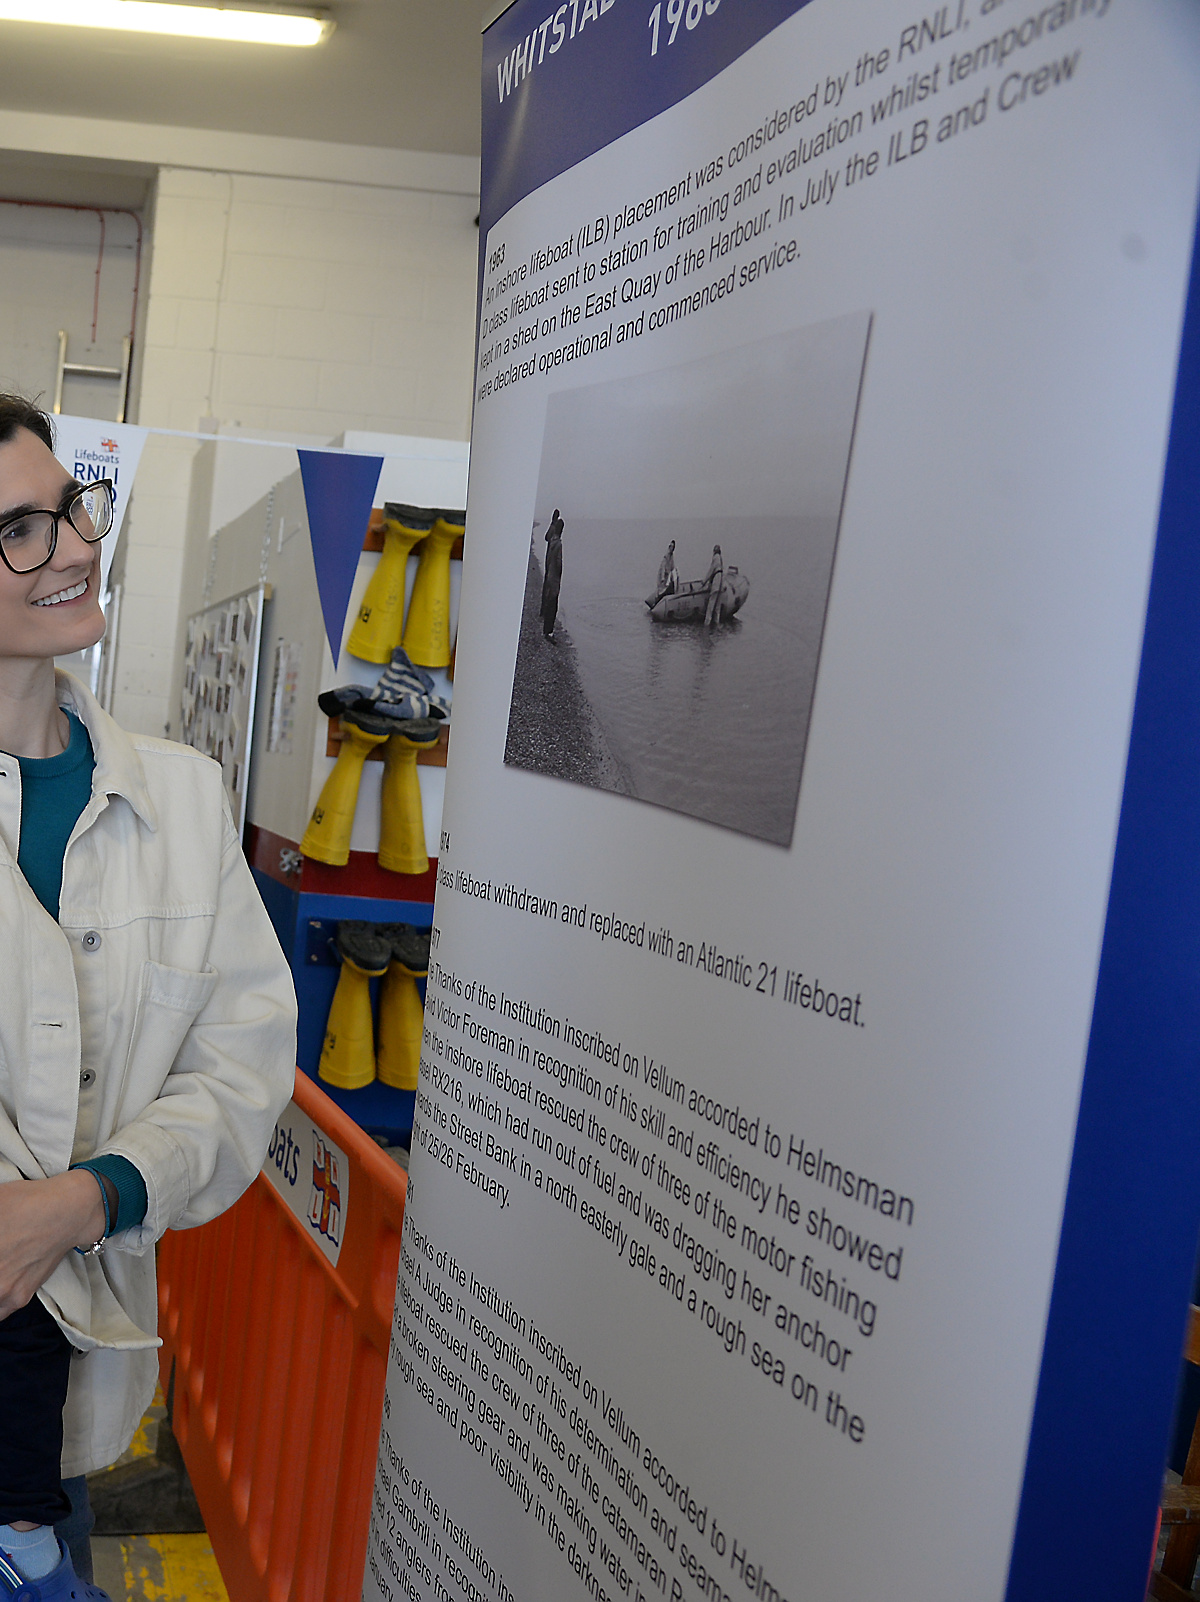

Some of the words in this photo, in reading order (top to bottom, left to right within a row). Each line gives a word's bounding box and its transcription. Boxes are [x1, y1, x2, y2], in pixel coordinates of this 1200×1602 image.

[488, 242, 506, 275] 1963
[489, 308, 508, 333] class
[510, 280, 550, 319] lifeboat
[552, 265, 582, 298] sent
[581, 261, 598, 284] to
[598, 239, 648, 276] station
[653, 225, 674, 252] for
[678, 192, 729, 240] training
[734, 164, 762, 206] and
[767, 112, 862, 185] evaluation
[872, 65, 940, 124] whilst
[494, 340, 502, 360] in
[504, 338, 510, 354] a
[512, 318, 541, 350] shed
[539, 316, 556, 338] on
[561, 305, 583, 329] the
[582, 285, 617, 319] East
[621, 270, 661, 303] Quay
[665, 254, 681, 285] of
[684, 249, 705, 276] the
[709, 209, 771, 262] Harbour.
[779, 194, 794, 222] In
[800, 170, 839, 210] July
[846, 151, 879, 186] the
[888, 120, 928, 165] ILB
[937, 89, 988, 142] and
[999, 54, 1078, 111] Crew
[495, 264, 527, 298] inshore
[530, 234, 573, 276] lifeboat
[577, 214, 609, 257] (ILB)
[613, 172, 691, 240] placement
[696, 156, 723, 190] was
[728, 84, 818, 168] considered
[824, 72, 848, 106] by
[856, 49, 889, 86] the
[494, 353, 539, 391] declared
[539, 323, 615, 375] operational
[615, 310, 644, 343] and
[649, 265, 736, 331] commenced
[739, 240, 800, 287] service.
[75, 449, 120, 464] Lifeboats
[455, 870, 491, 900] lifeboat
[494, 883, 557, 919] withdrawn
[561, 904, 586, 928] and
[590, 912, 645, 947] replaced
[649, 928, 673, 958] with
[677, 942, 693, 965] an
[696, 942, 752, 987] Atlantic
[756, 962, 777, 996] 21
[784, 970, 864, 1027] lifeboat.
[420, 1129, 428, 1148] of
[428, 1133, 454, 1168] 25/26
[456, 1152, 509, 1209] February.
[431, 1065, 464, 1110] RX216,
[468, 1092, 502, 1125] which
[505, 1107, 529, 1140] had
[532, 1128, 552, 1154] run
[556, 1143, 576, 1170] out
[578, 1155, 592, 1179] of
[593, 1160, 616, 1197] fuel
[618, 1185, 642, 1217] and
[645, 1203, 669, 1239] was
[673, 1222, 736, 1299] dragging
[741, 1270, 771, 1316] her
[775, 1305, 852, 1372] anchor
[432, 1032, 443, 1056] the
[445, 1039, 483, 1078] inshore
[486, 1060, 532, 1103] lifeboat
[535, 1090, 585, 1133] rescued
[588, 1114, 606, 1146] the
[610, 1134, 639, 1168] crew
[642, 1154, 656, 1179] of
[657, 1160, 690, 1206] three
[695, 1191, 711, 1219] of
[713, 1199, 736, 1239] the
[741, 1225, 796, 1277] motor
[800, 1255, 876, 1337] fishing
[435, 963, 462, 996] Thanks
[465, 981, 476, 1002] of
[478, 985, 496, 1011] the
[500, 992, 560, 1038] Institution
[564, 1018, 620, 1067] inscribed
[623, 1054, 638, 1078] on
[644, 1056, 685, 1105] Vellum
[689, 1090, 760, 1147] accorded
[764, 1124, 781, 1158] to
[787, 1134, 914, 1225] Helmsman
[438, 998, 460, 1030] Victor
[462, 1013, 514, 1056] Foreman
[518, 1037, 529, 1063] in
[533, 1050, 601, 1101] recognition
[605, 1084, 618, 1109] of
[619, 1088, 637, 1122] his
[640, 1105, 665, 1140] skill
[668, 1126, 694, 1158] and
[697, 1142, 771, 1213] efficiency
[776, 1184, 800, 1225] he
[806, 1208, 903, 1281] showed
[433, 1103, 447, 1129] the
[450, 1113, 483, 1152] Street
[486, 1134, 517, 1172] Bank
[520, 1154, 531, 1181] in
[535, 1170, 542, 1189] a
[546, 1176, 577, 1212] north
[581, 1201, 628, 1256] easterly
[629, 1240, 656, 1276] gale
[659, 1265, 685, 1302] and
[688, 1290, 697, 1313] a
[701, 1300, 746, 1355] rough
[751, 1342, 785, 1387] sea
[792, 1374, 818, 1411] on
[826, 1392, 864, 1443] the
[470, 1272, 525, 1337] Institution
[529, 1320, 581, 1390] inscribed
[602, 1390, 640, 1458] Vellum
[643, 1448, 707, 1536] accorded
